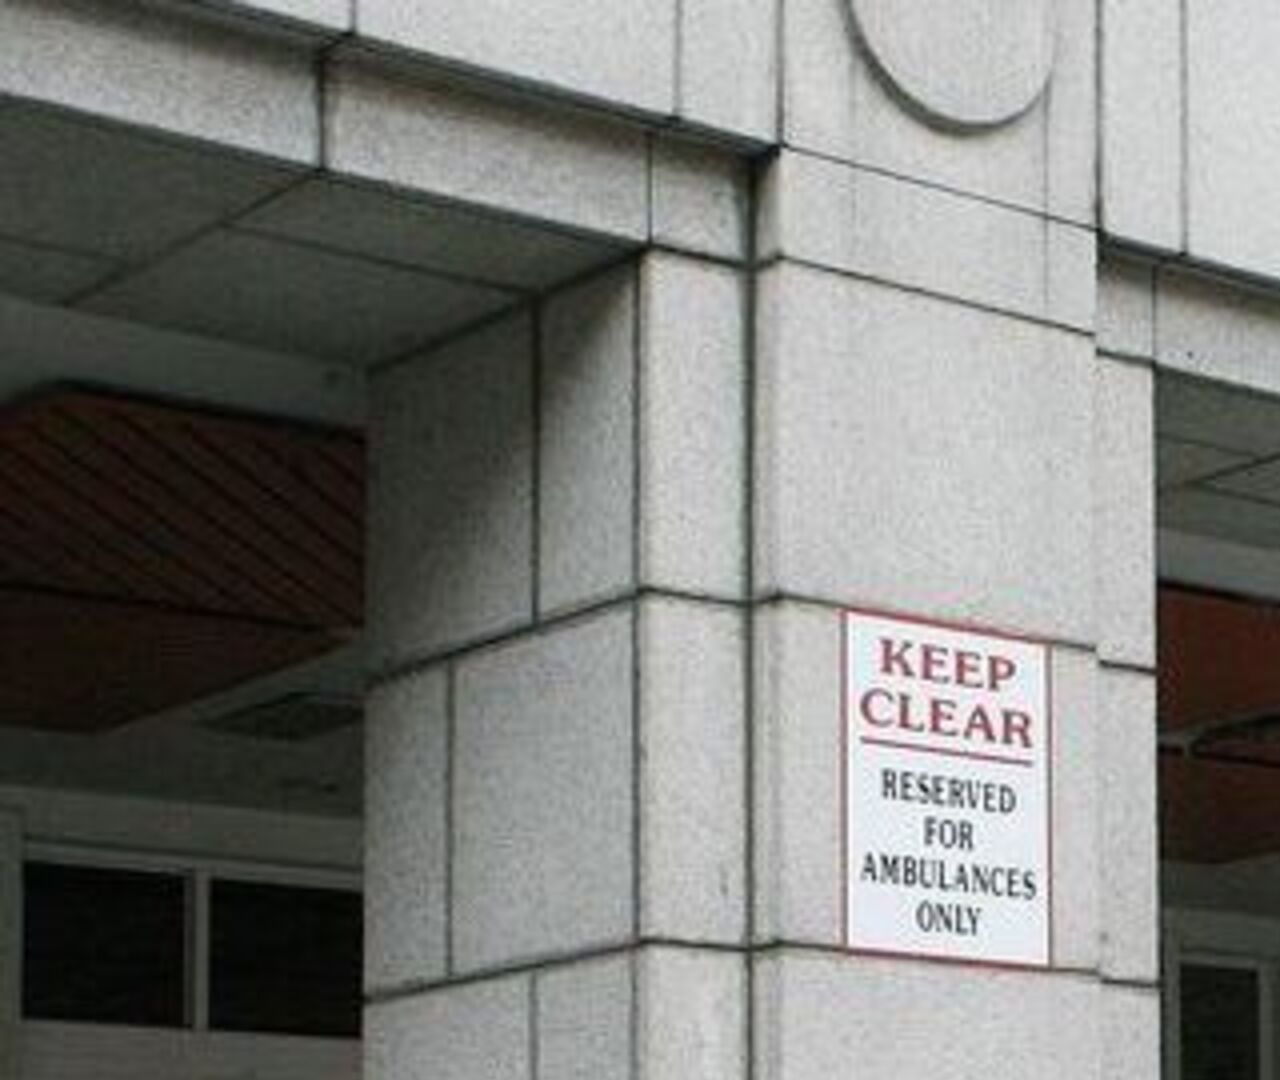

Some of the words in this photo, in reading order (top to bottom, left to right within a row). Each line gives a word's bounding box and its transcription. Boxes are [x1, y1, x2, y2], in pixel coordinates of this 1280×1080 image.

[879, 637, 1017, 692] KEEP
[859, 687, 1033, 748] CLEAR
[881, 768, 1018, 815] RESERVED
[923, 816, 975, 850] FOR
[860, 851, 1038, 901] AMBULANCES
[915, 900, 983, 937] ONLY
